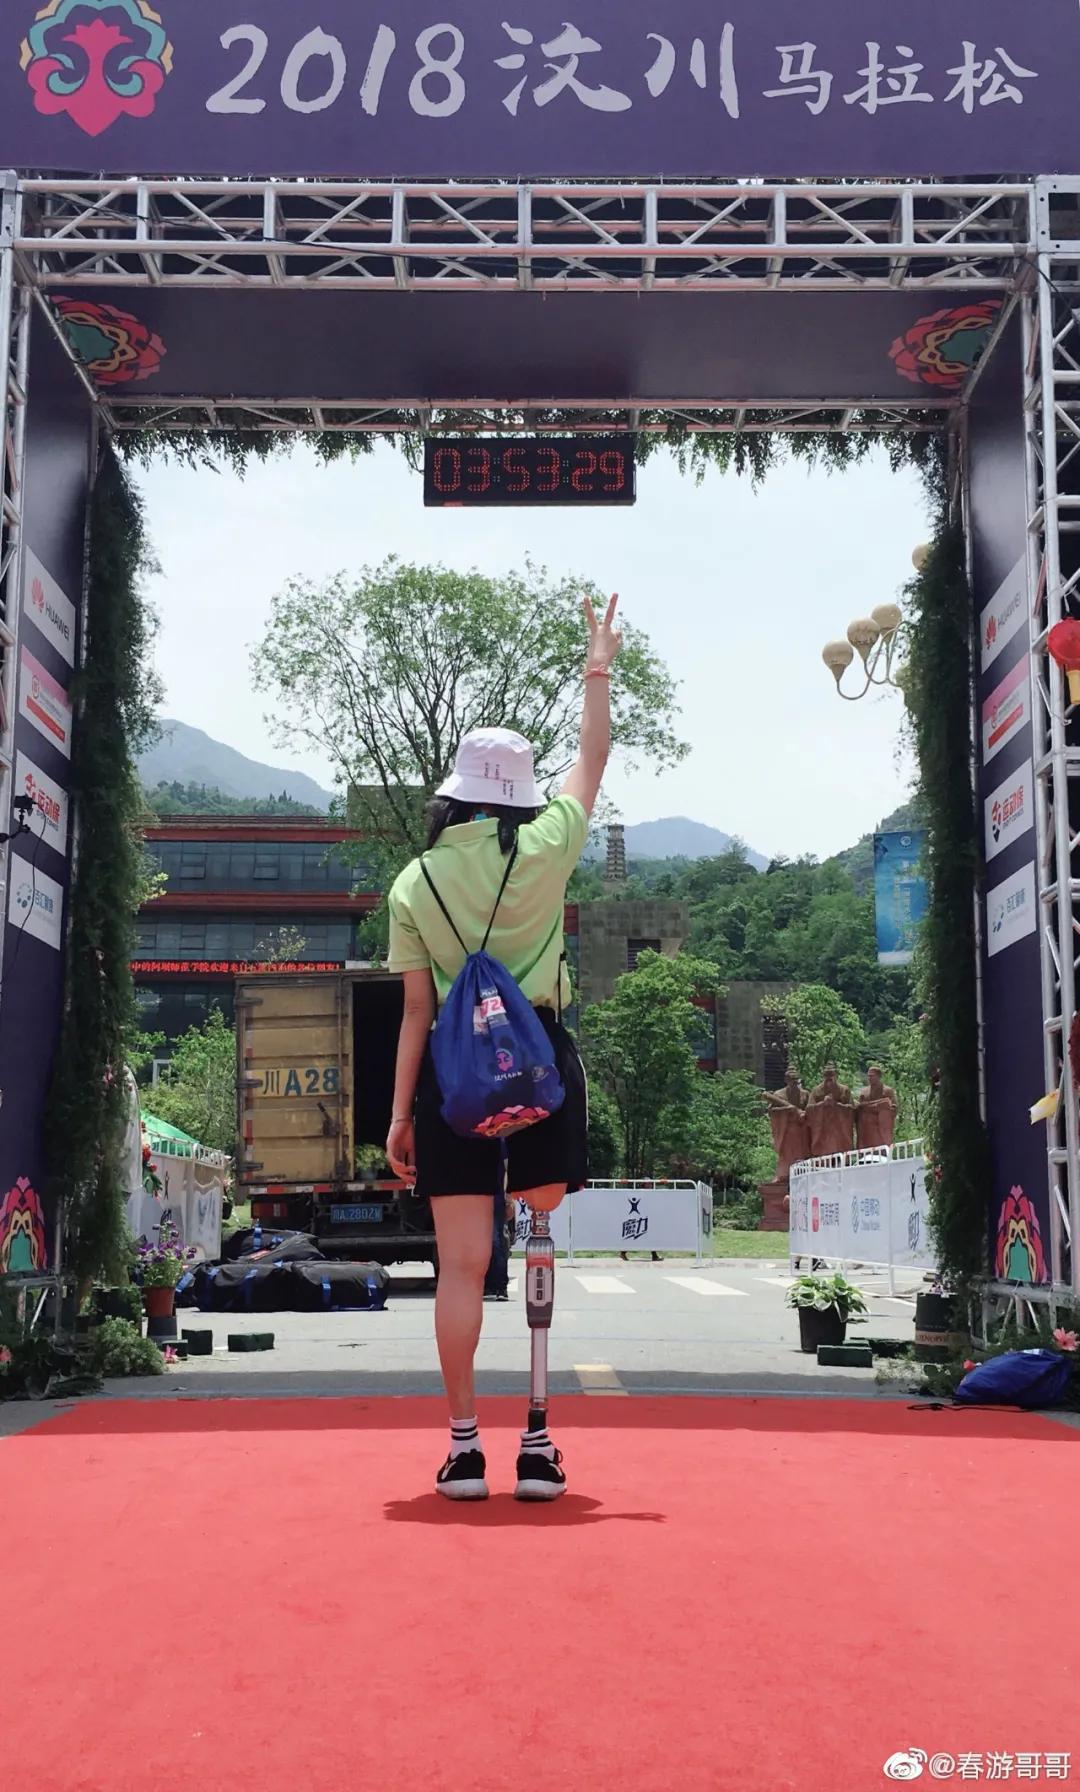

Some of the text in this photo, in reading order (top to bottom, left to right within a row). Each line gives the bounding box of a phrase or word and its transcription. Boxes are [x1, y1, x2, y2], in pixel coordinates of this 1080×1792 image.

[206, 22, 1038, 118] 2018 汶川马拉松
[433, 447, 625, 492] 03:53:29
[45, 606, 70, 642] HUAWEI
[480, 998, 503, 1018] 72
[262, 1067, 340, 1096] 川A28
